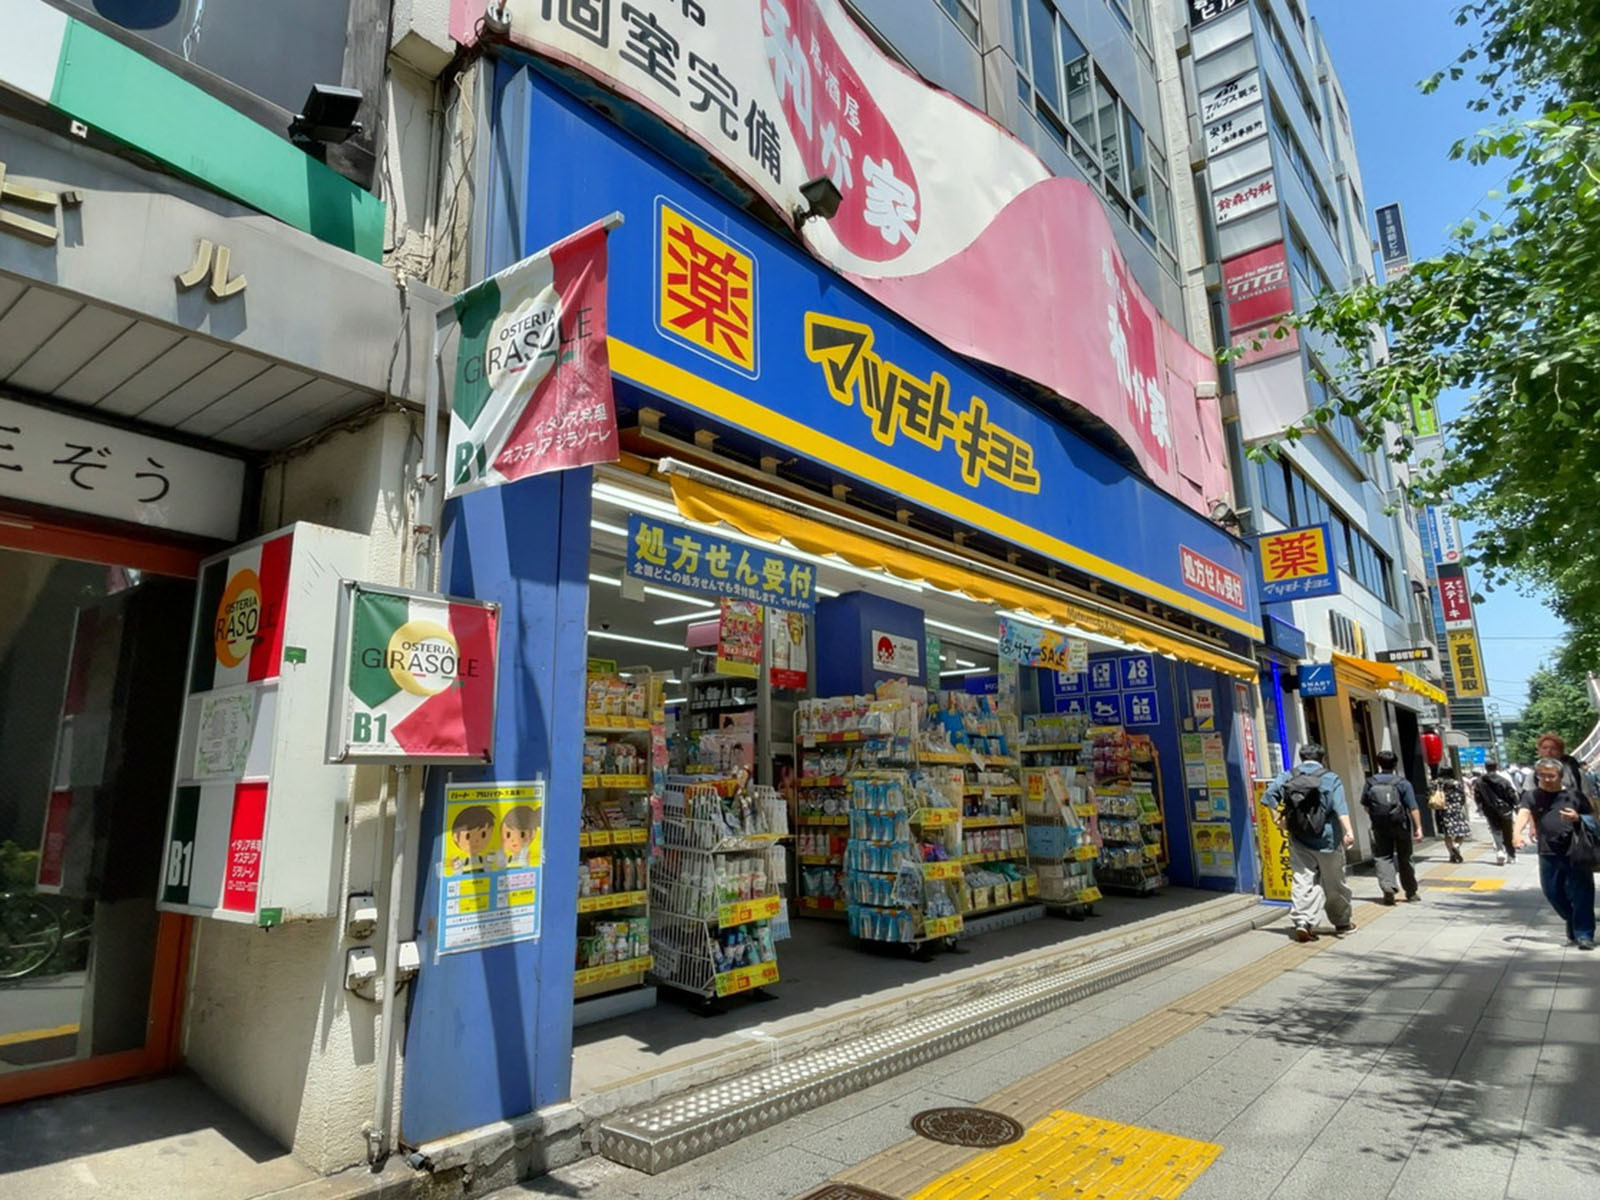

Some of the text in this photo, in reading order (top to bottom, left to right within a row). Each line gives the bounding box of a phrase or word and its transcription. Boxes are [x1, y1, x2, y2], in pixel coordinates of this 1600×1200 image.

[667, 222, 749, 361] 薬
[808, 317, 1040, 490] マツモトキヨシ
[635, 522, 812, 599] 処方せん受付
[1183, 551, 1244, 607] 処方せん受付
[1268, 533, 1321, 579] 薬
[361, 648, 480, 678] GIRASOLE
[402, 641, 454, 655] OSTERIA
[353, 712, 387, 743] B1
[168, 840, 193, 886] B1
